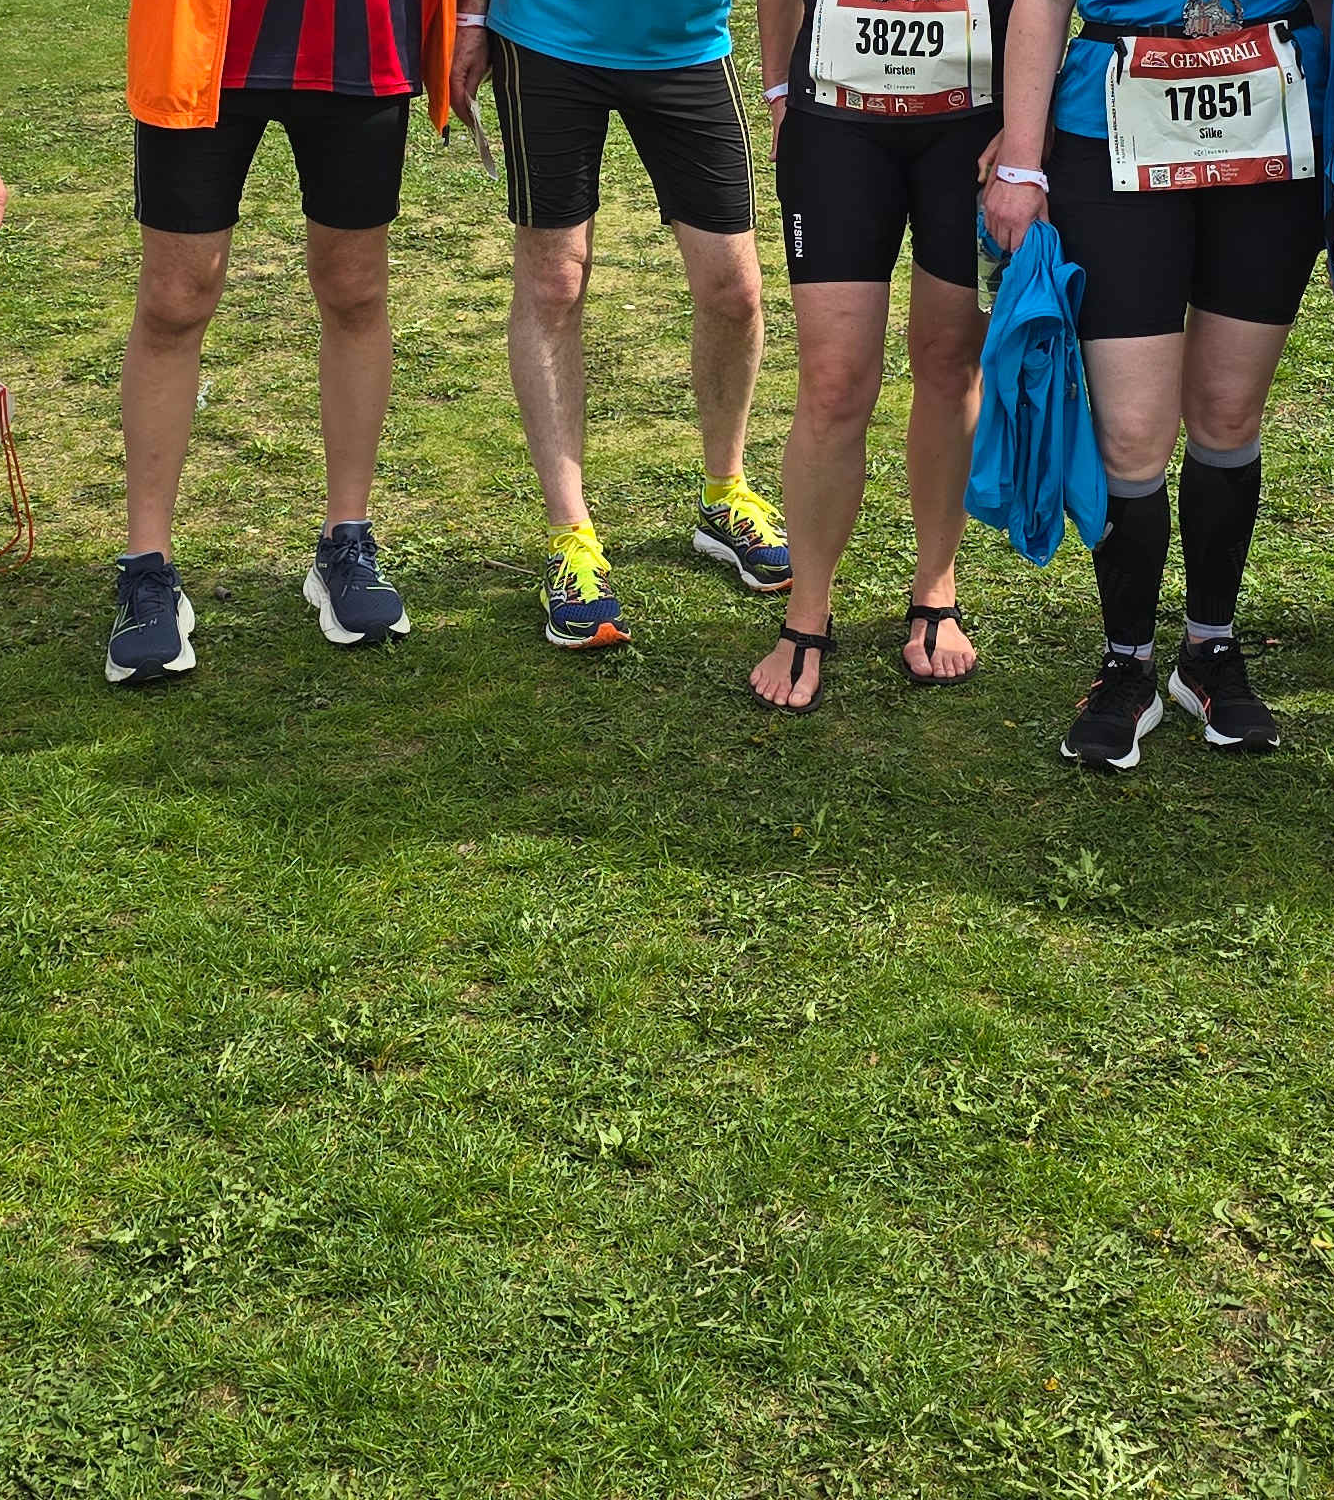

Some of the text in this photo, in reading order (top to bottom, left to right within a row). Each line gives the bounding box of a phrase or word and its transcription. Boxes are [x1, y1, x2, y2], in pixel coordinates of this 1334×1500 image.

[973, 19, 978, 30] F
[855, 17, 944, 58] 38229
[1170, 40, 1263, 69] GENERALI
[884, 63, 916, 76] Kirsten
[1286, 72, 1292, 84] G
[1165, 80, 1252, 122] 17851
[1199, 127, 1223, 139] Silke
[793, 213, 804, 258] FUSION
